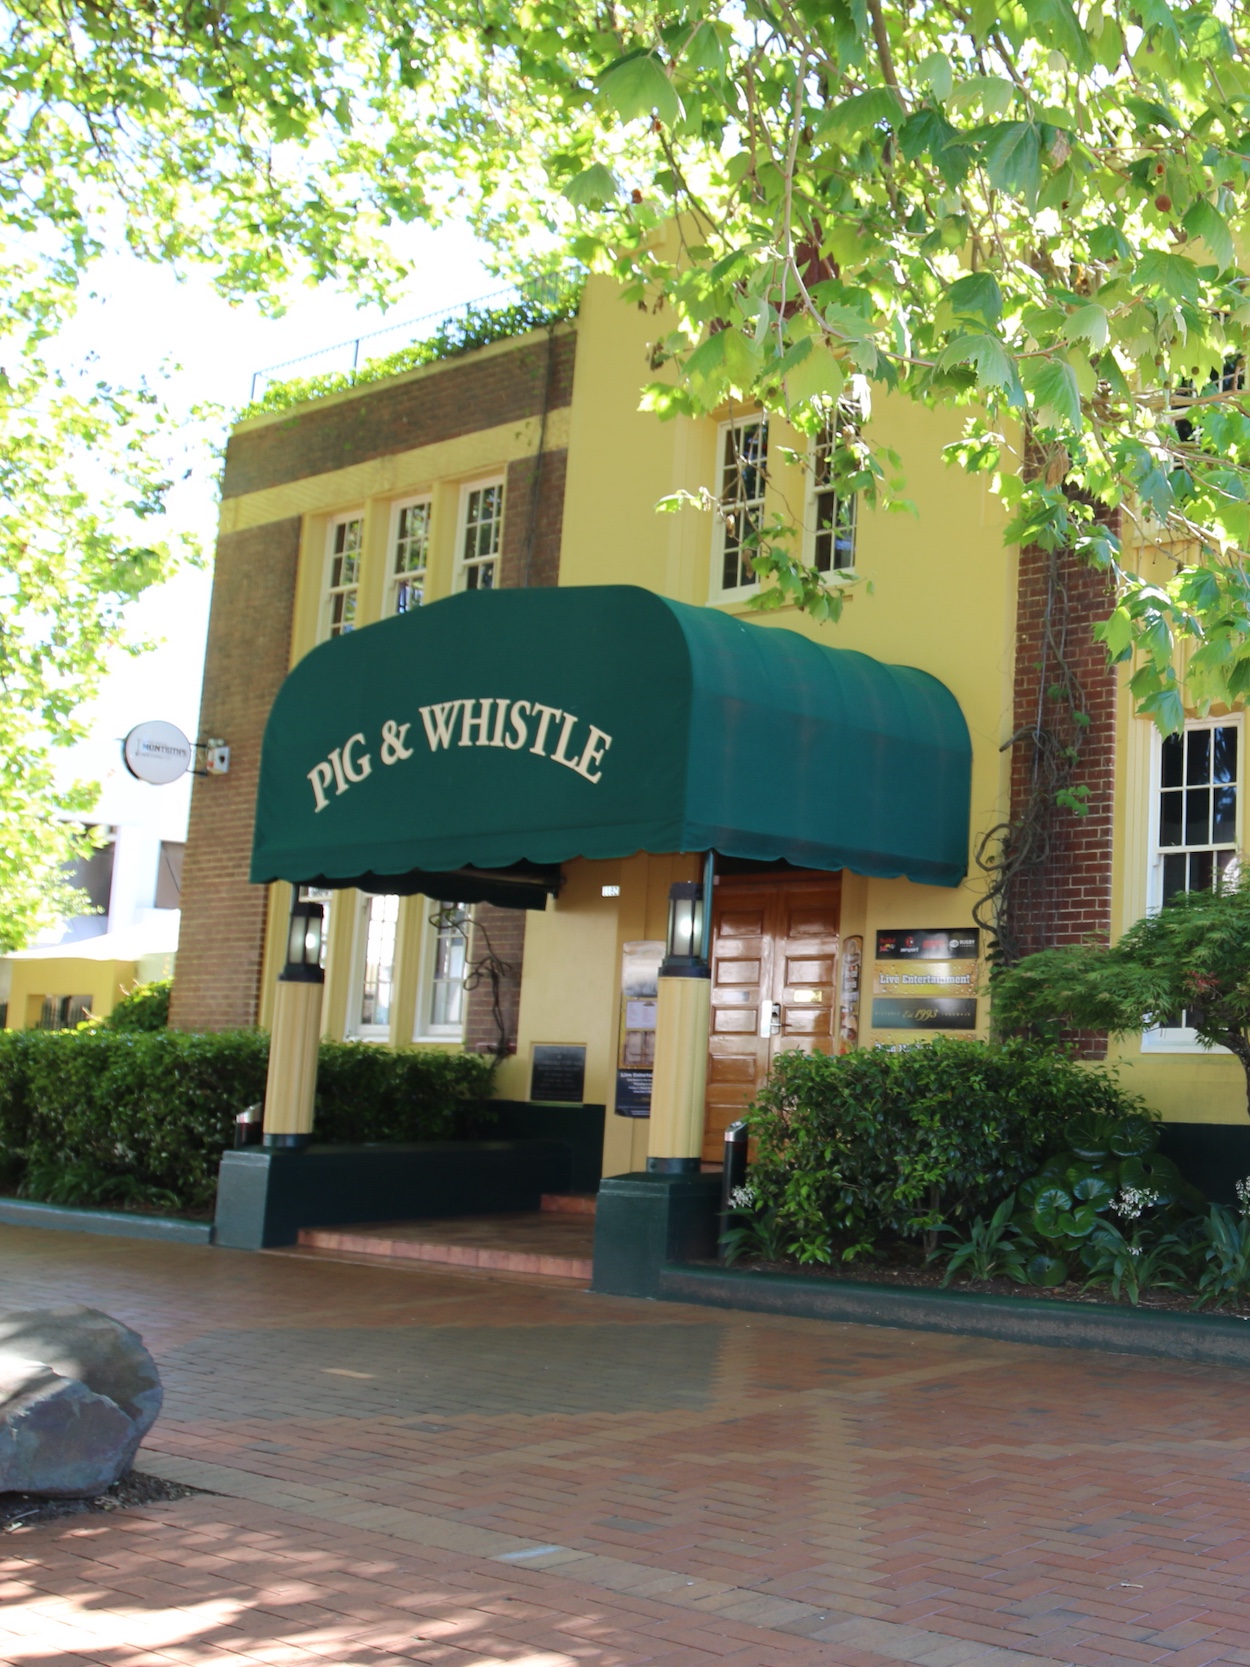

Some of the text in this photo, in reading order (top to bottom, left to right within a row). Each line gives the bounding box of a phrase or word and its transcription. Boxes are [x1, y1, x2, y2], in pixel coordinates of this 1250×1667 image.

[307, 697, 613, 813] PIG & WHISTLE
[880, 974, 971, 985] Live Entertainment
[914, 1008, 939, 1021] 1993
